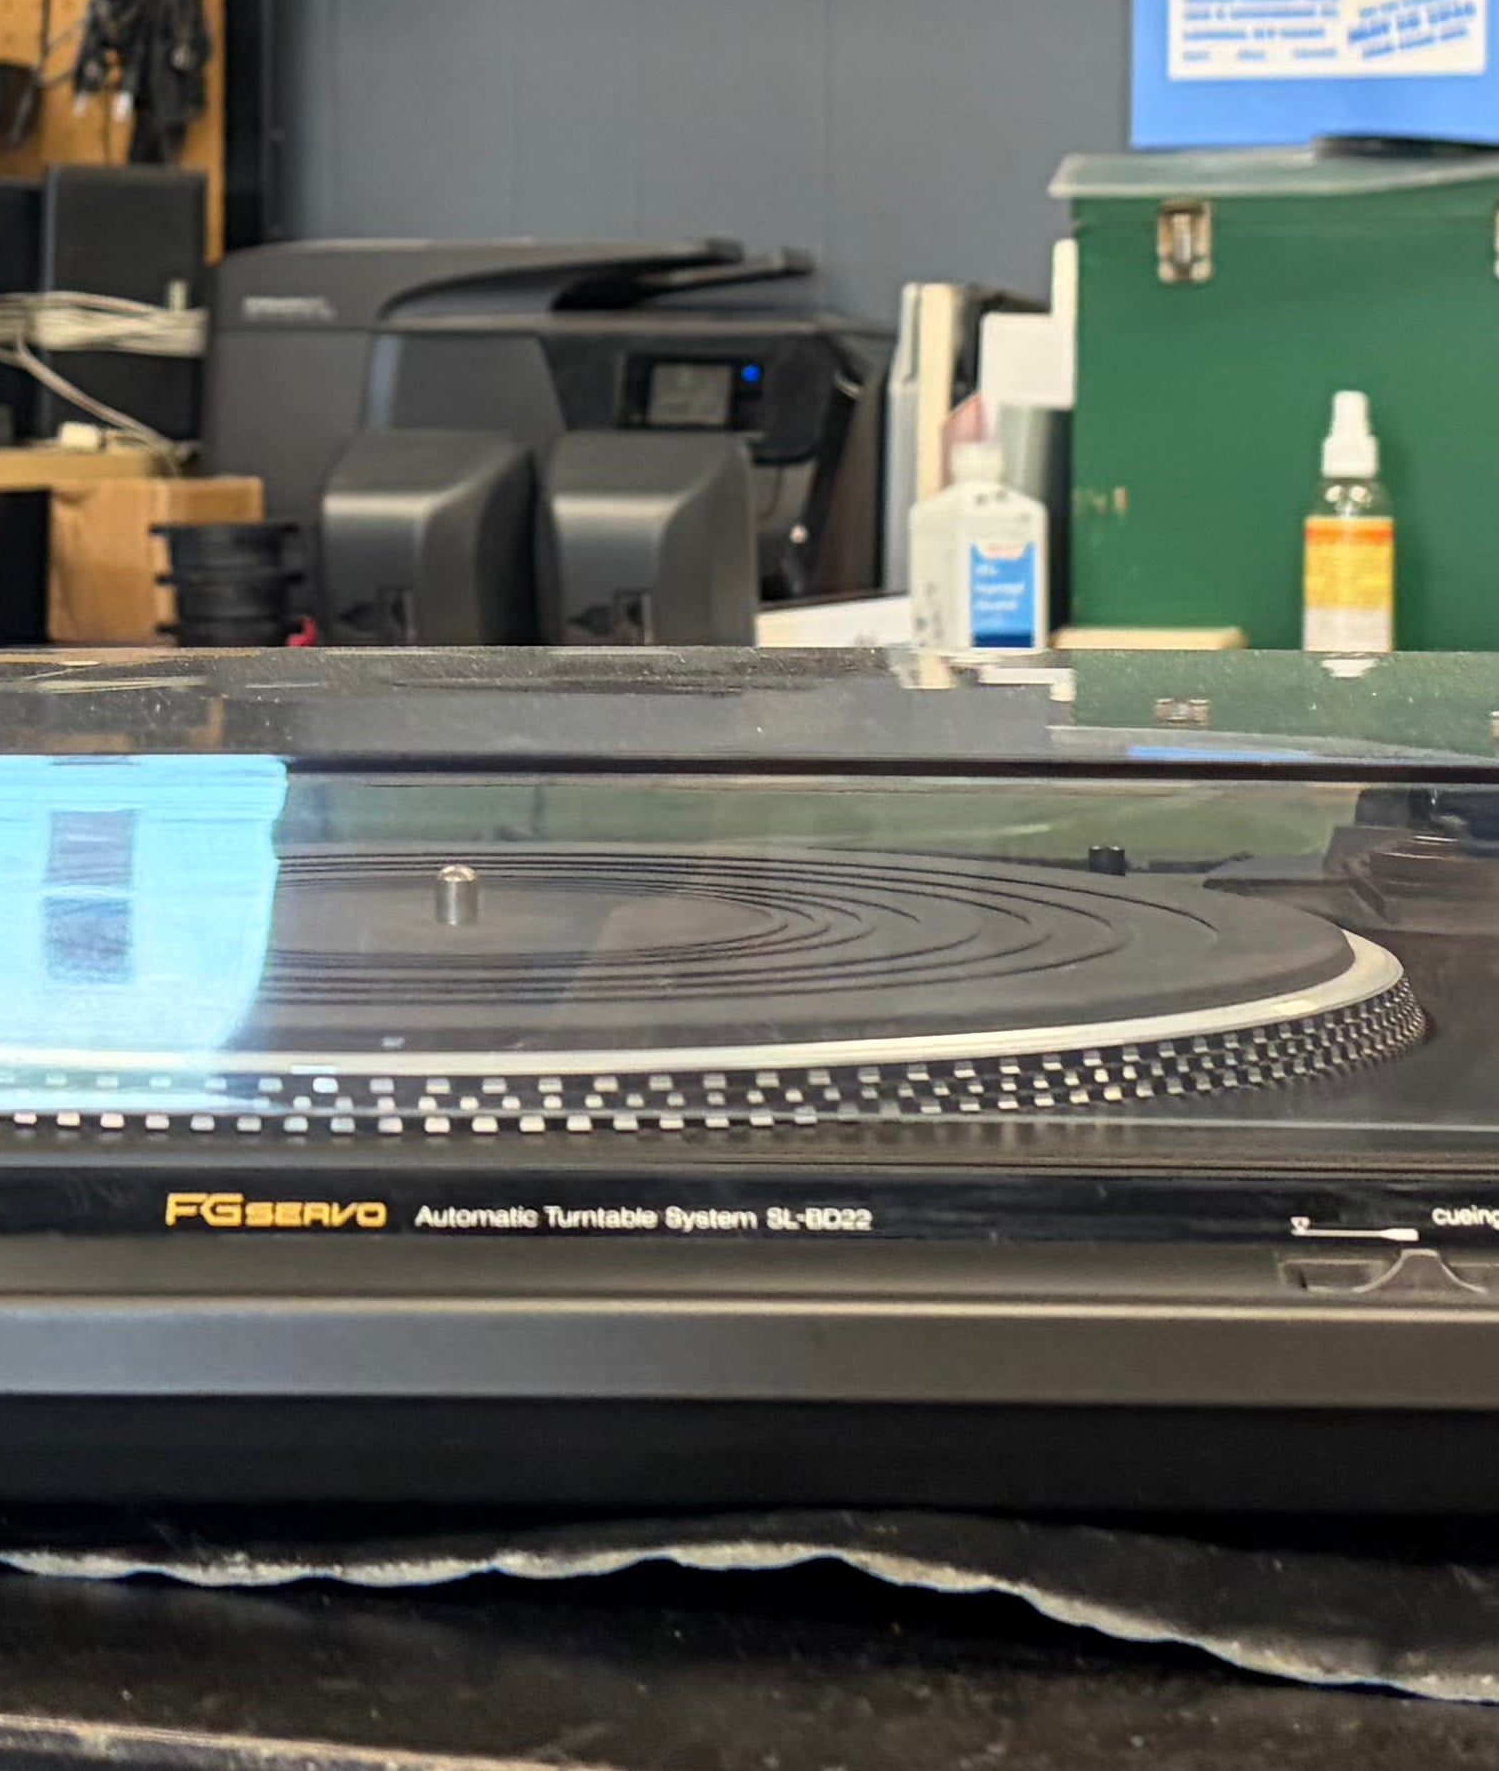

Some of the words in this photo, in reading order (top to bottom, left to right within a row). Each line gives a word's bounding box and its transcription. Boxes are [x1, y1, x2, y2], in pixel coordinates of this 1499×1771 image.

[414, 1204, 539, 1228] Automatic
[543, 1205, 658, 1228] Turntable
[664, 1205, 758, 1233] System
